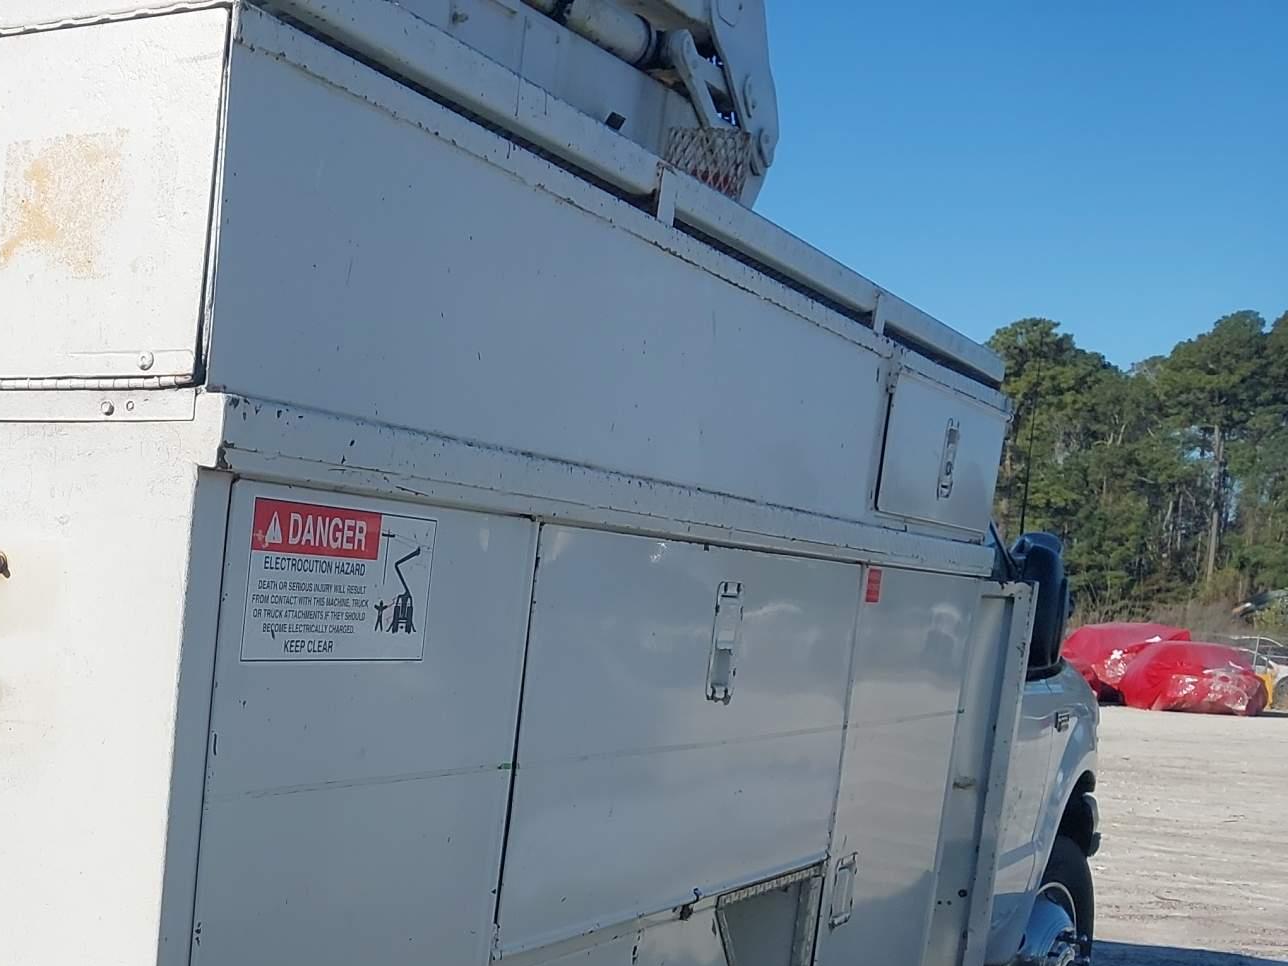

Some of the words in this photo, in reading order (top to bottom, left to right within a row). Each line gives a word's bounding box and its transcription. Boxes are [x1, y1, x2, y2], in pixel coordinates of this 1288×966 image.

[288, 512, 367, 551] DANGER
[264, 556, 332, 574] ELECTROCUTION
[335, 562, 366, 576] HAZARD
[258, 580, 278, 590] DEATH
[279, 581, 287, 591] OR
[289, 582, 313, 592] SERIOUS
[314, 584, 332, 592] INJURY
[334, 584, 345, 593] WILL
[347, 585, 367, 594] RESULT
[252, 594, 269, 604] FROM
[271, 594, 298, 605] CONTACT
[299, 596, 312, 606] WITH
[314, 597, 325, 606] THIS
[352, 599, 369, 608] TRUCK
[253, 609, 262, 618] OR
[264, 609, 282, 618] TRUCK
[284, 610, 323, 620] ATTACHMENTS
[324, 611, 330, 620] IF
[331, 611, 344, 620] THEY
[345, 612, 366, 621] SHOULD
[263, 623, 288, 632] BECOME
[288, 624, 328, 633] ELECTRICALLY
[284, 640, 305, 653] KEEP
[307, 640, 333, 653] CLEAR
